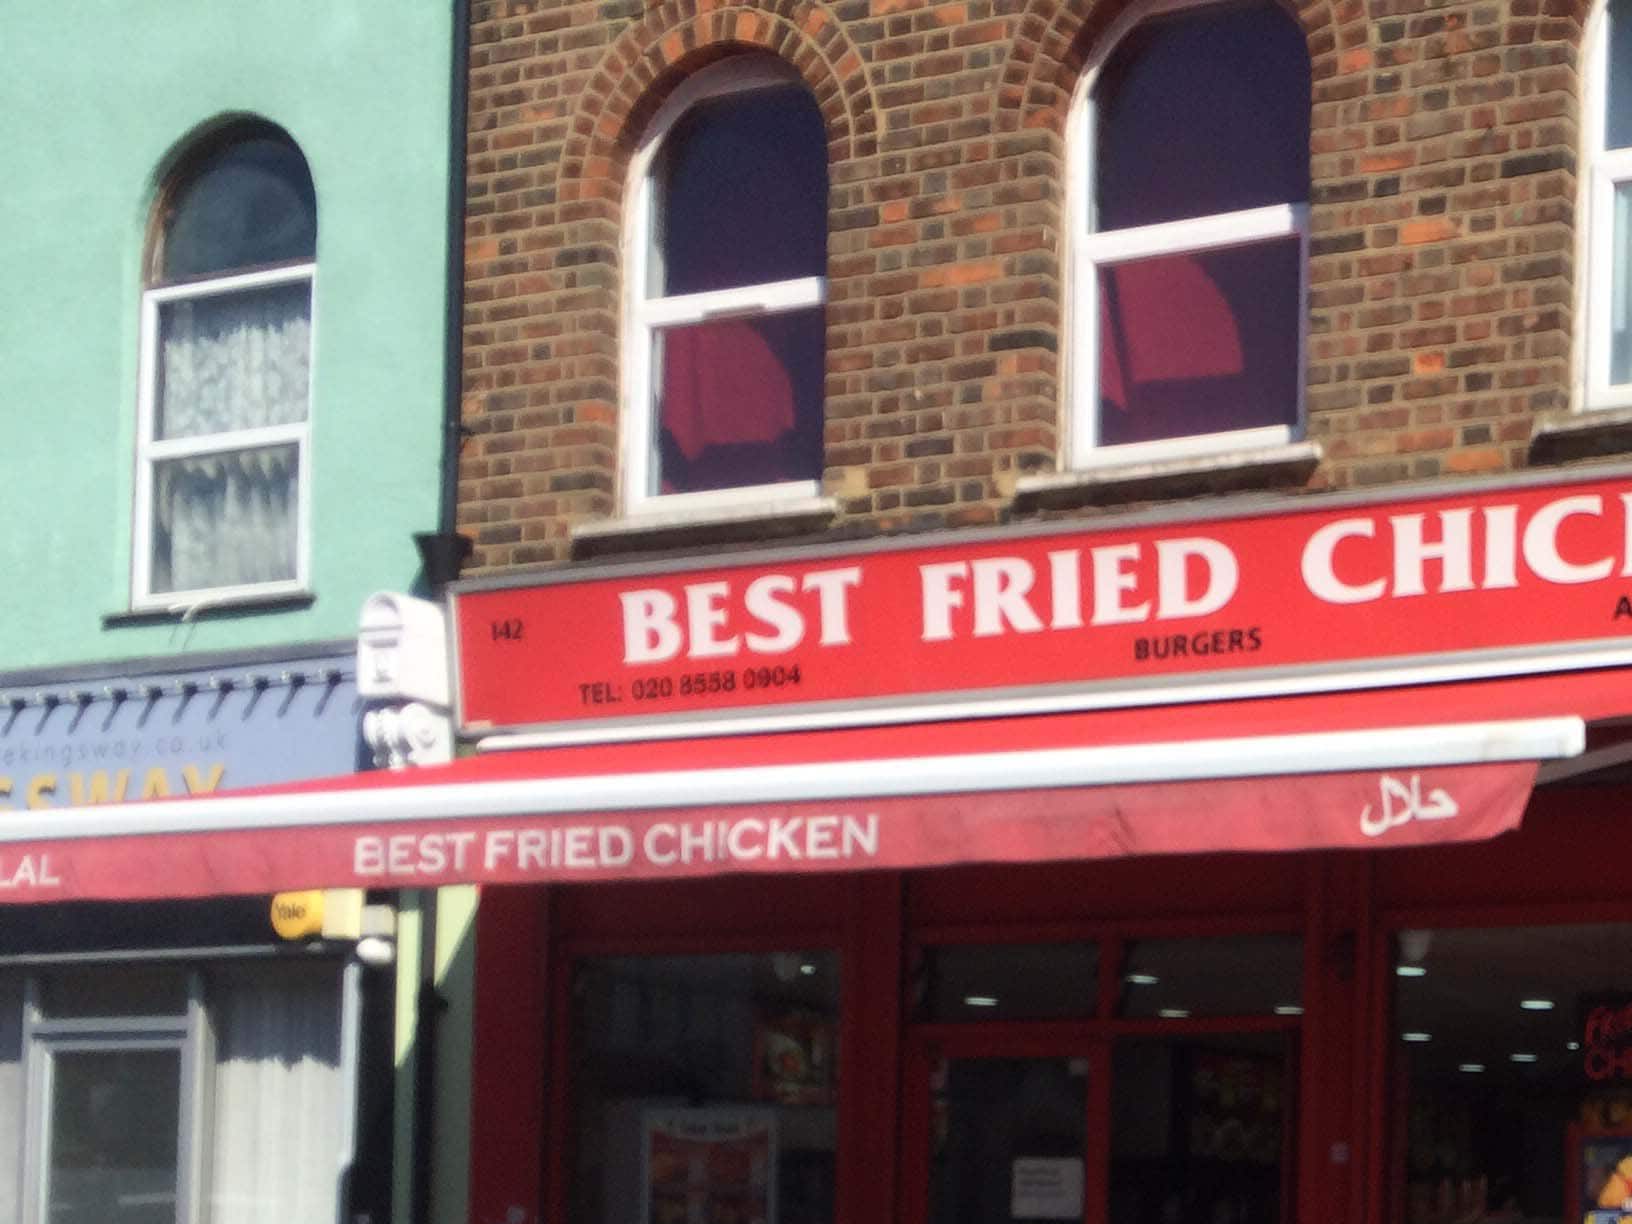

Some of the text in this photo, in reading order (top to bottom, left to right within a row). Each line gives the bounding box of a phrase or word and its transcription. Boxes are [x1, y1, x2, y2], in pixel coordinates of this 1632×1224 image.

[618, 567, 861, 664] BEST
[919, 536, 1240, 642] FRIED
[491, 619, 523, 641] 142
[1134, 627, 1262, 661] BURGERS
[578, 682, 622, 704] TEL:
[631, 678, 673, 700] 020
[743, 665, 801, 689] 0904
[1360, 774, 1458, 836] حلال
[354, 813, 880, 875] BEST FRIED CHICKEN
